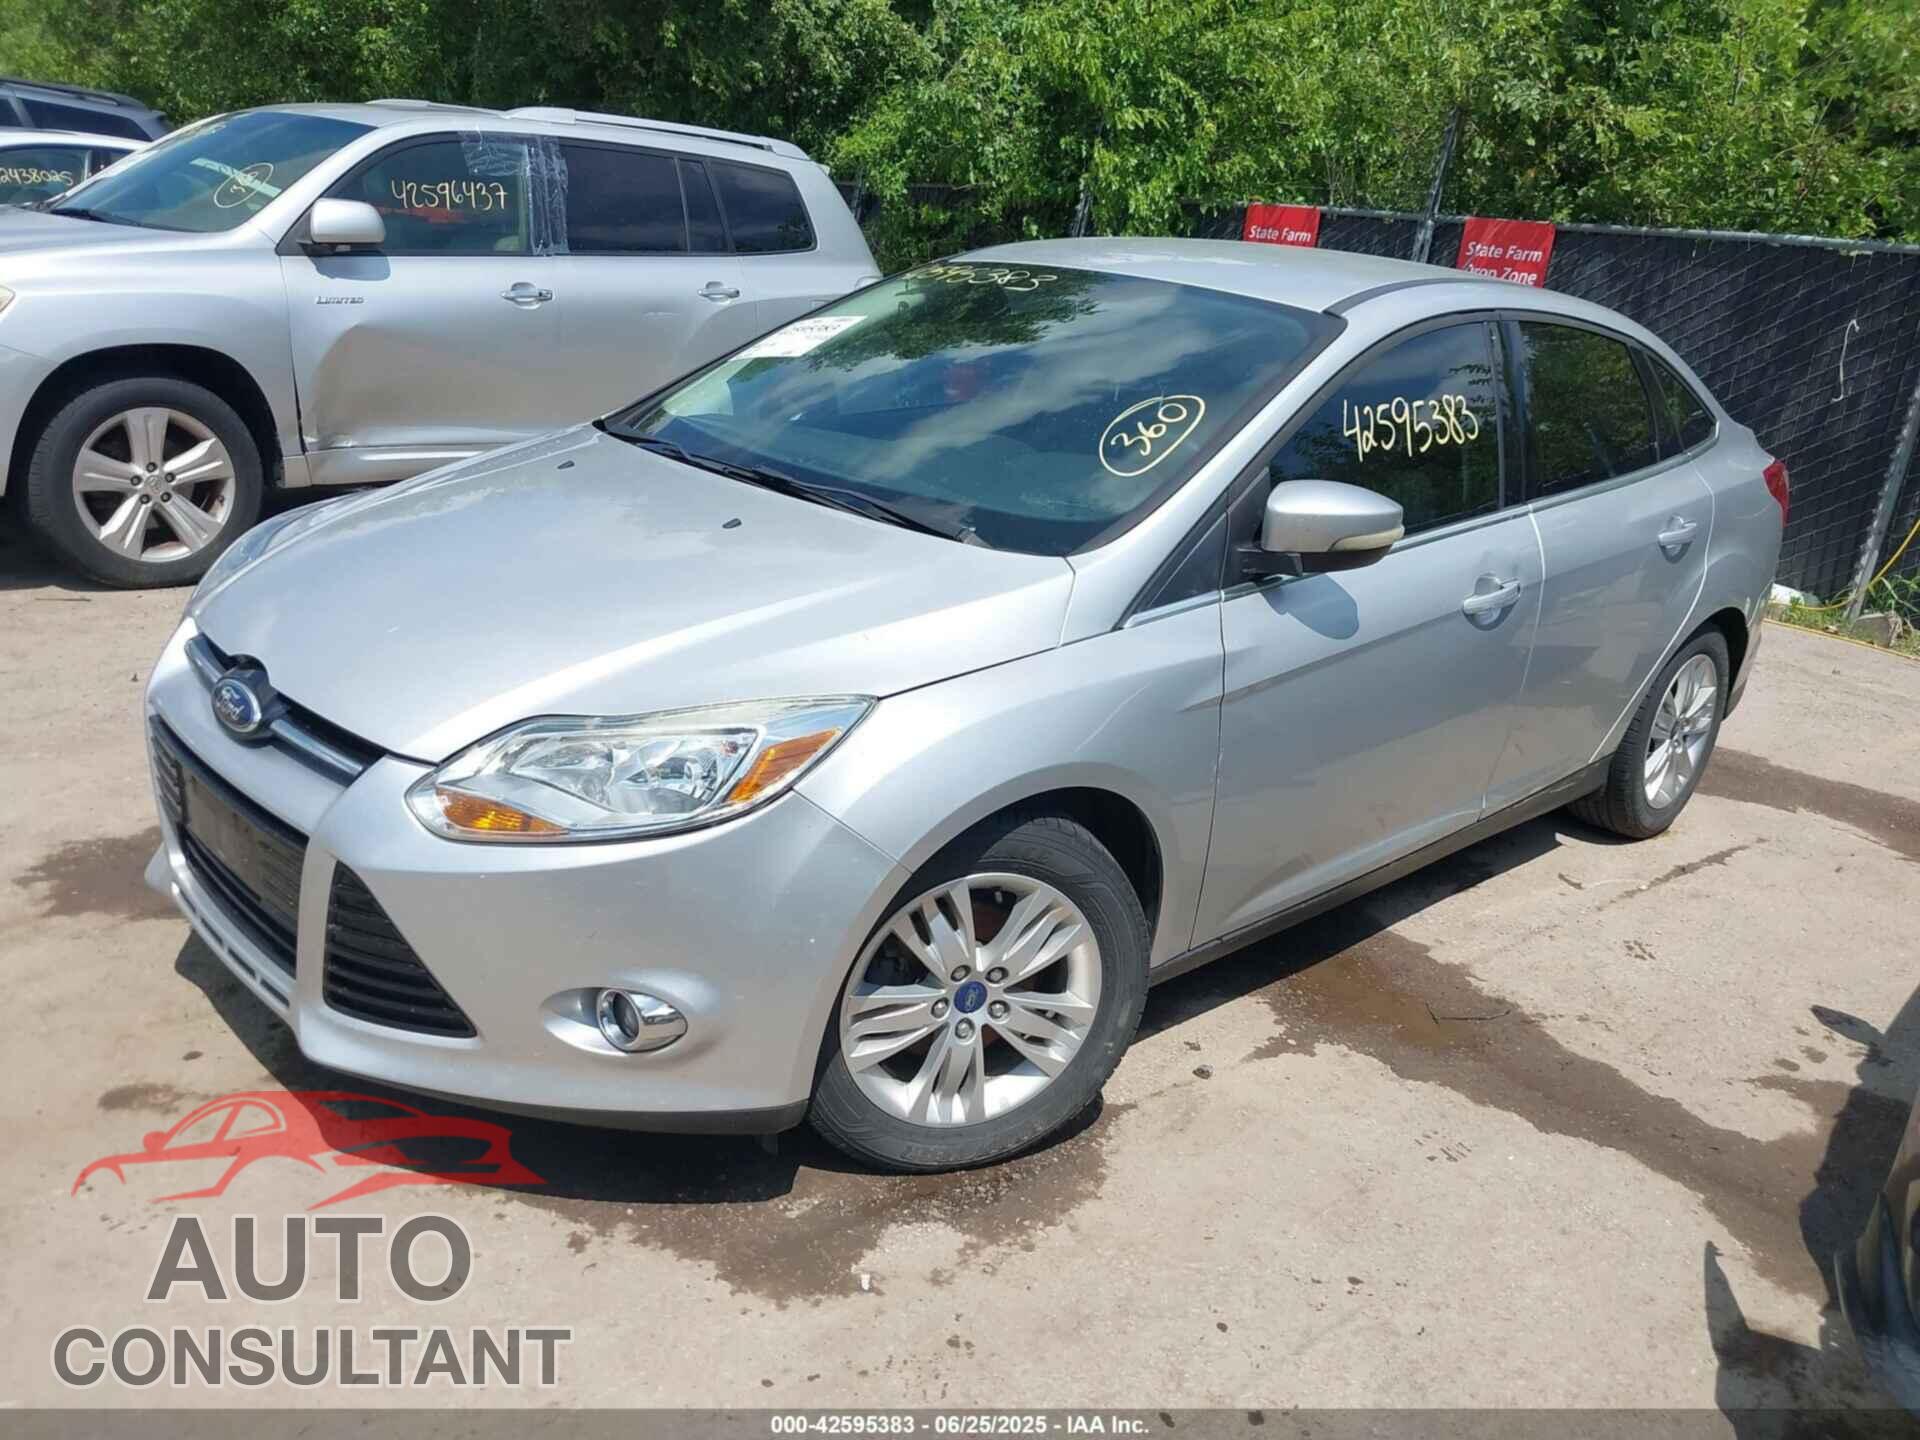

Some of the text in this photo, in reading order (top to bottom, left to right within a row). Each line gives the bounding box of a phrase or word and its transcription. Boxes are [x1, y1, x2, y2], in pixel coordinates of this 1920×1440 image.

[391, 180, 508, 210] 42596437
[1249, 225, 1312, 242] State Farm
[1466, 241, 1543, 262] State Farm
[1502, 267, 1537, 285] Zone
[1110, 402, 1188, 457] 360
[1343, 394, 1479, 462] 42595383
[215, 686, 245, 721] Ford
